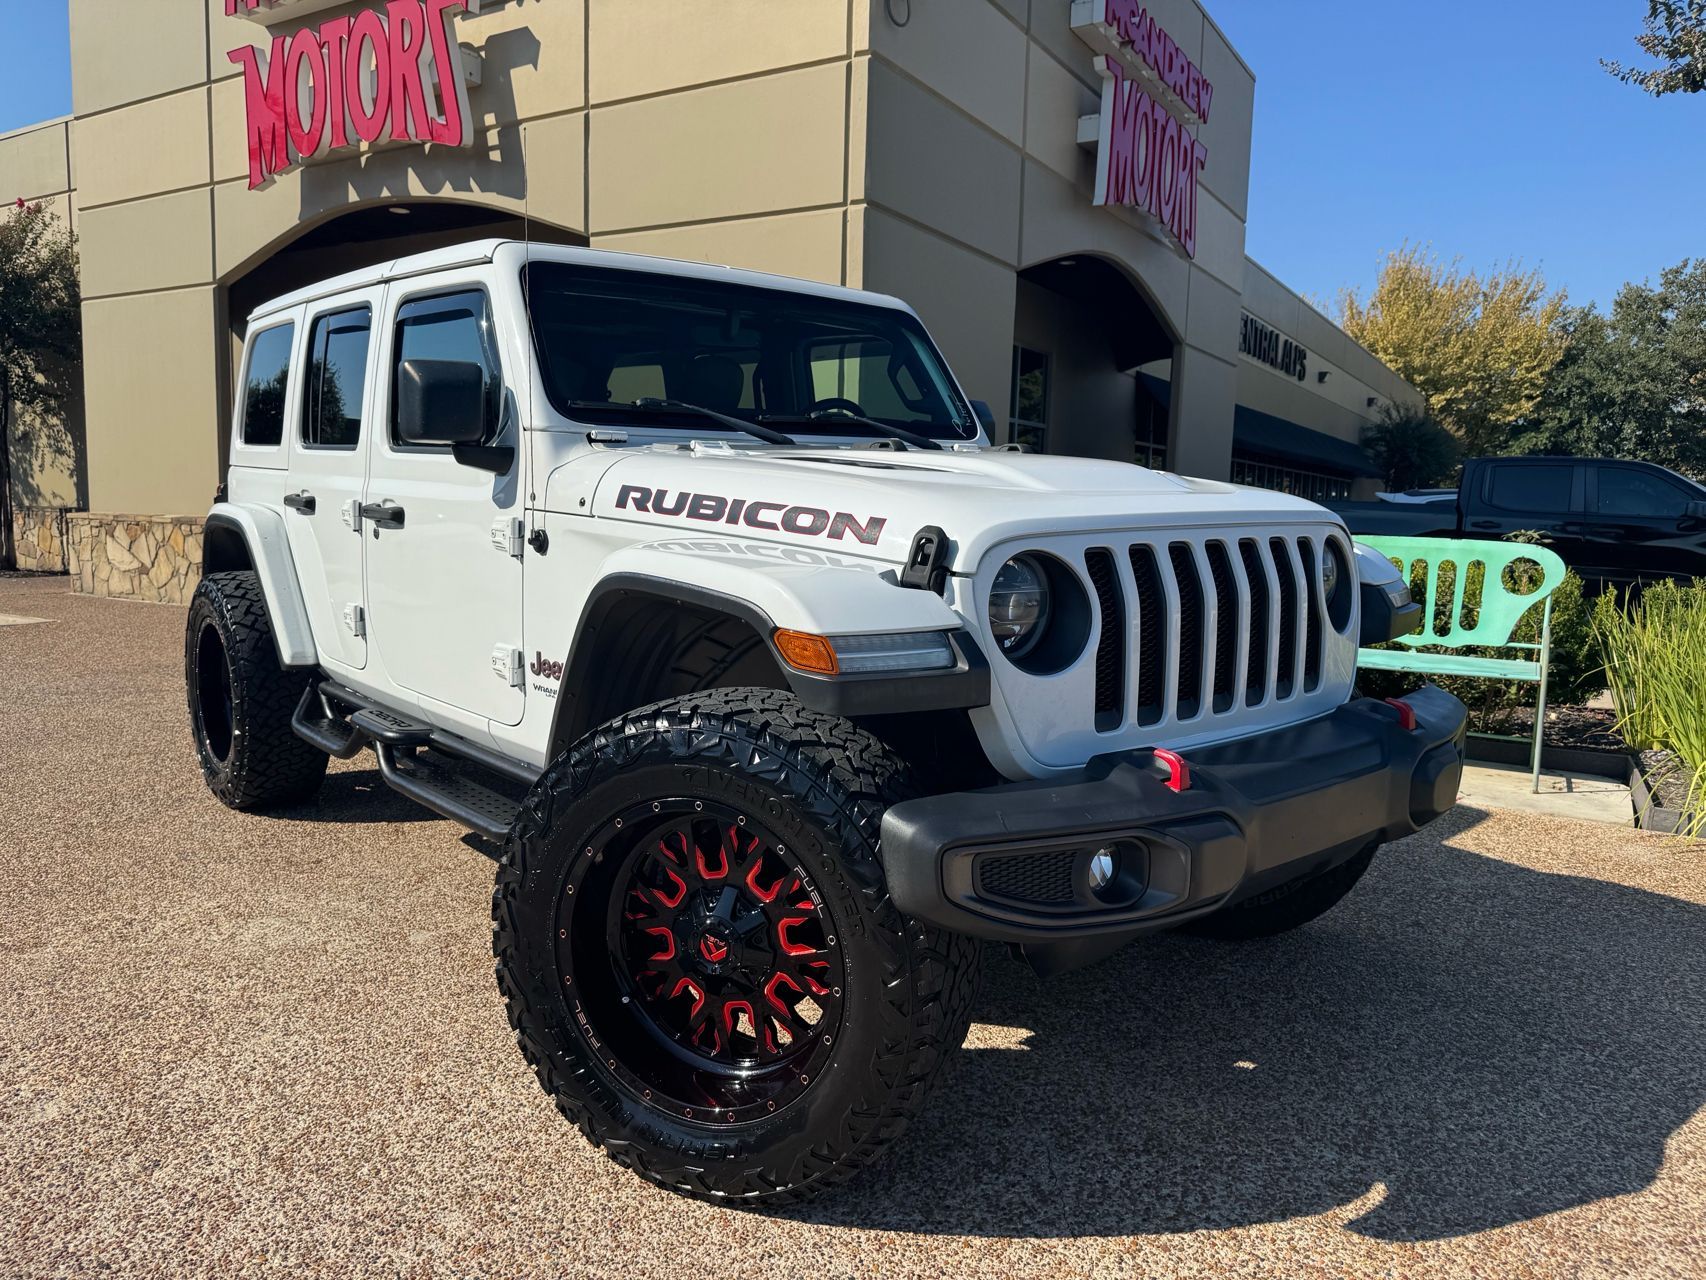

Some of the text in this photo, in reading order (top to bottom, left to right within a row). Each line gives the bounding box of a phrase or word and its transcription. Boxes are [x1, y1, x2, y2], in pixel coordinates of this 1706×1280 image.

[227, 0, 468, 190] MOTORS
[1105, 54, 1207, 260] MOTORS
[1280, 339, 1307, 381] ALPS
[615, 484, 887, 546] RUBICON
[530, 651, 564, 681] Jee
[793, 864, 824, 919] FUEL
[575, 999, 602, 1050] FUEL
